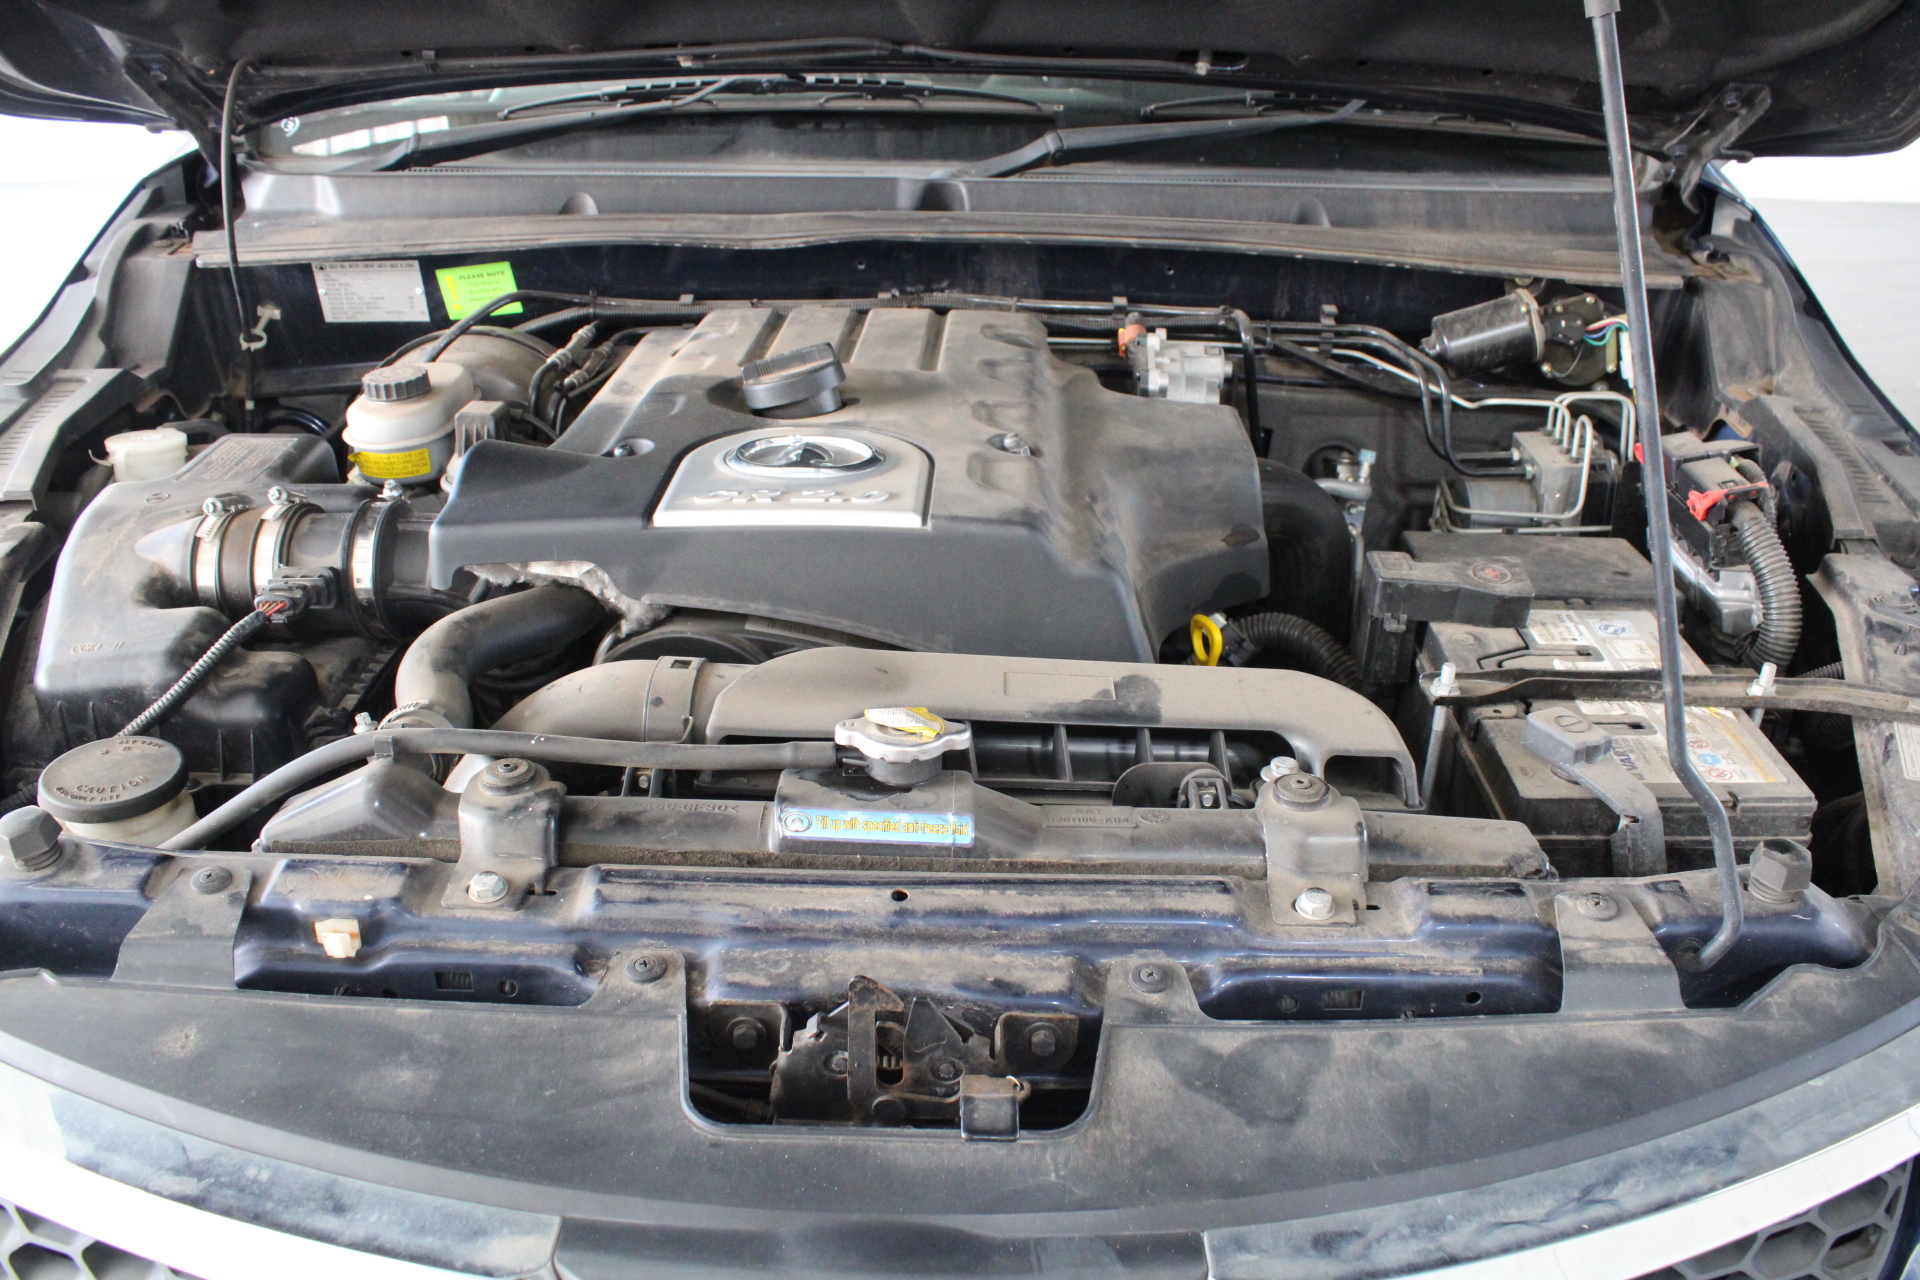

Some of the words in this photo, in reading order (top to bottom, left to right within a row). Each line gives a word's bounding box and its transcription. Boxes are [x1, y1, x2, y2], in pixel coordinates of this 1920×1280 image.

[458, 272, 485, 280] PLEASE
[486, 270, 506, 278] NOTE
[76, 775, 149, 795] CAUTION
[815, 815, 830, 830] Fill
[831, 818, 842, 833] up
[843, 816, 861, 831] with
[862, 817, 901, 834] specified
[902, 819, 949, 835] anti-freeze
[950, 821, 969, 836] fluid
